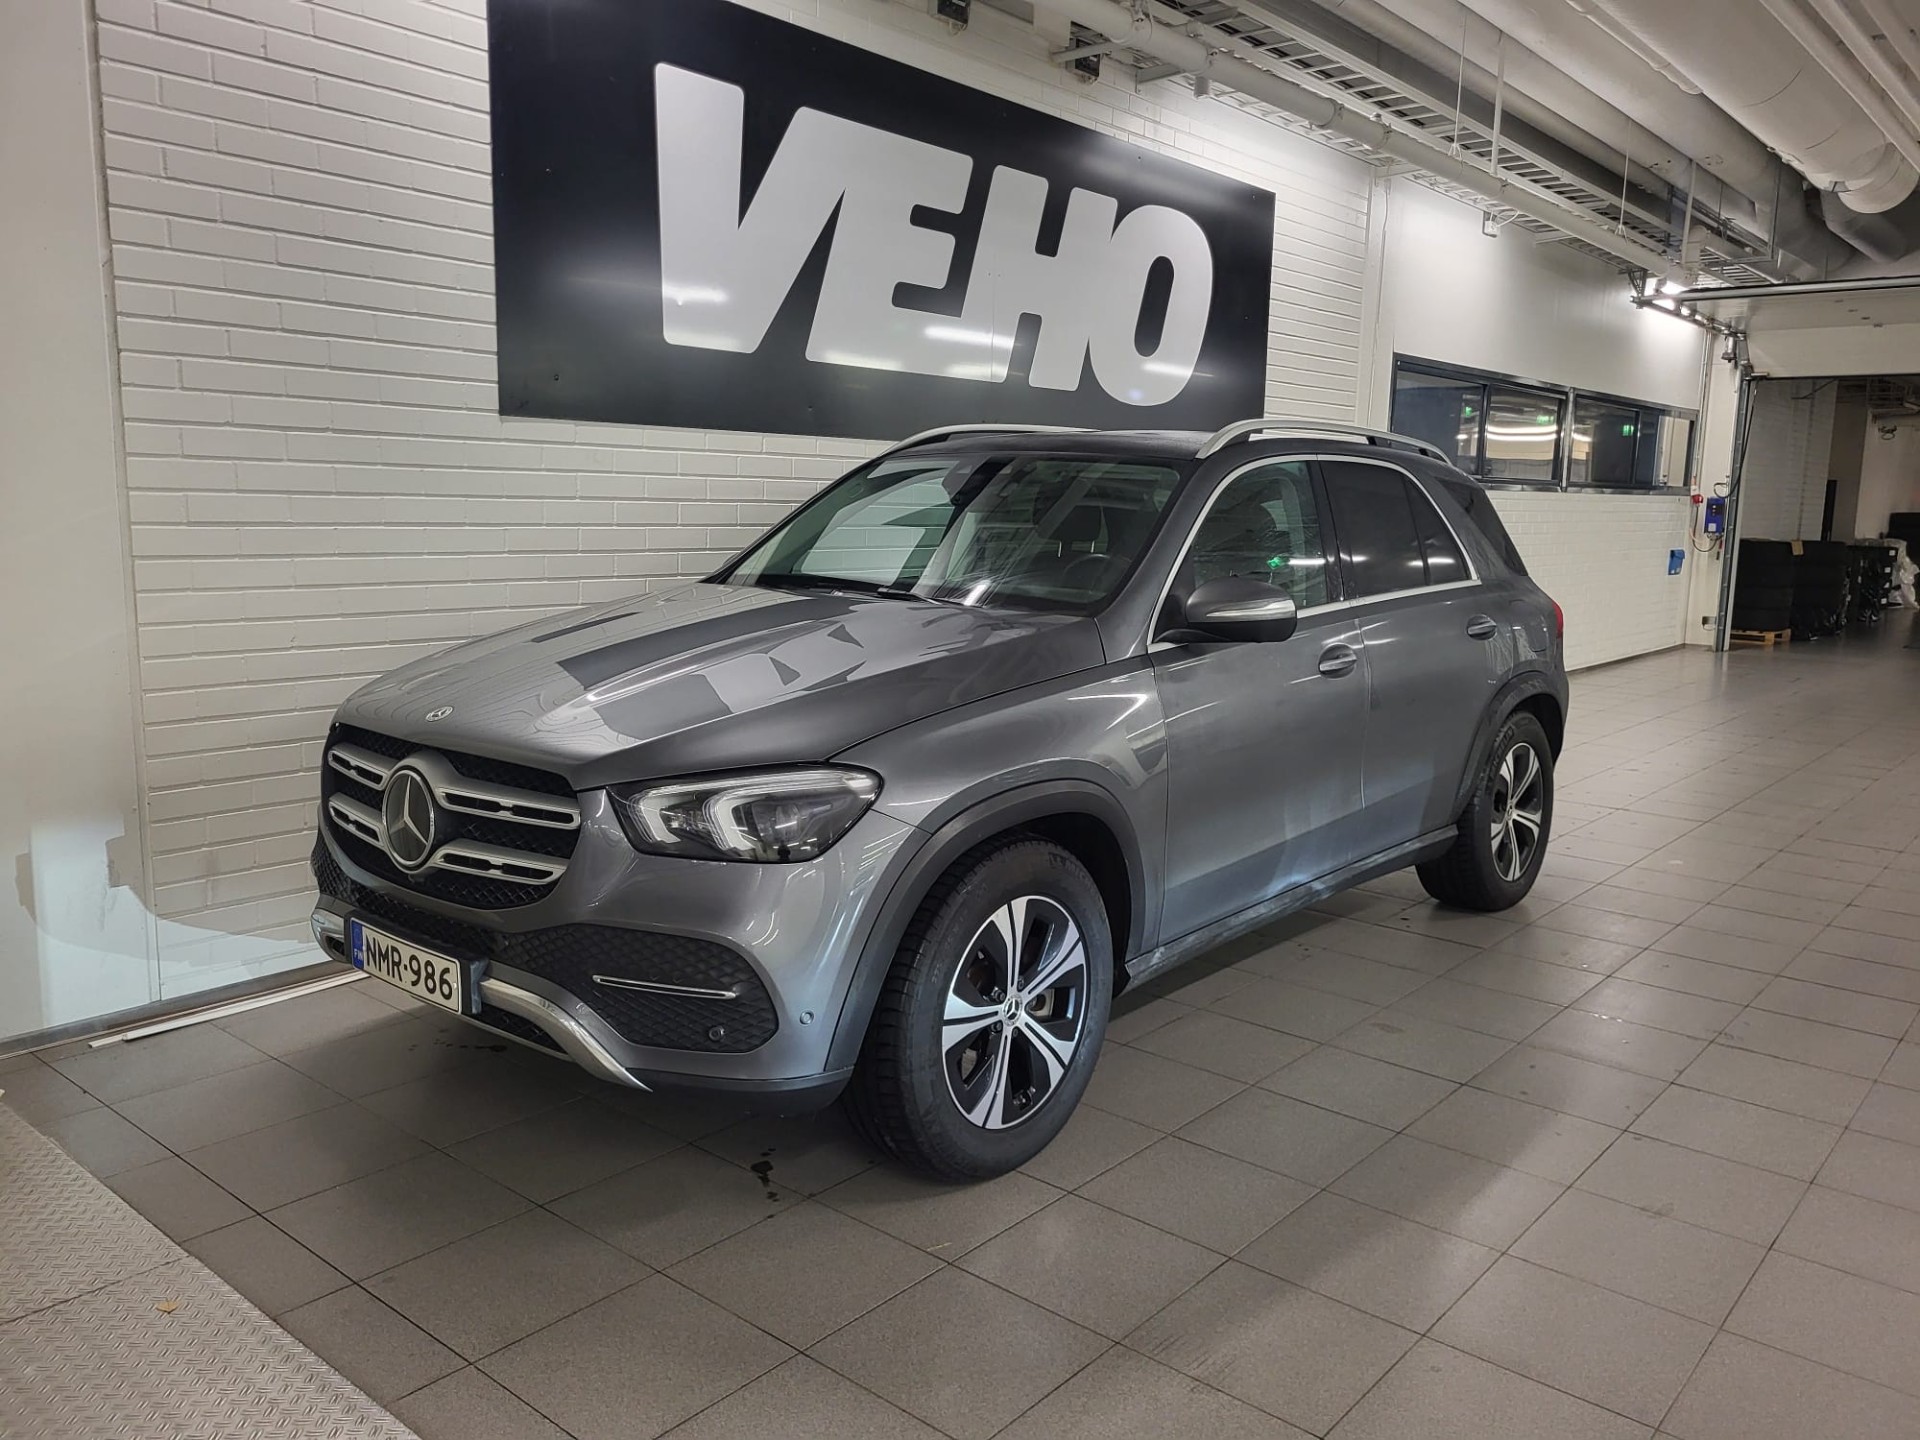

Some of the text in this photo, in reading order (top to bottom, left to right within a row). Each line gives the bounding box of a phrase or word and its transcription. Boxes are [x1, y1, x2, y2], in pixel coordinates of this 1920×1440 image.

[655, 62, 1213, 406] VEHO
[353, 948, 363, 960] FIN
[365, 934, 453, 1001] NMR-986
